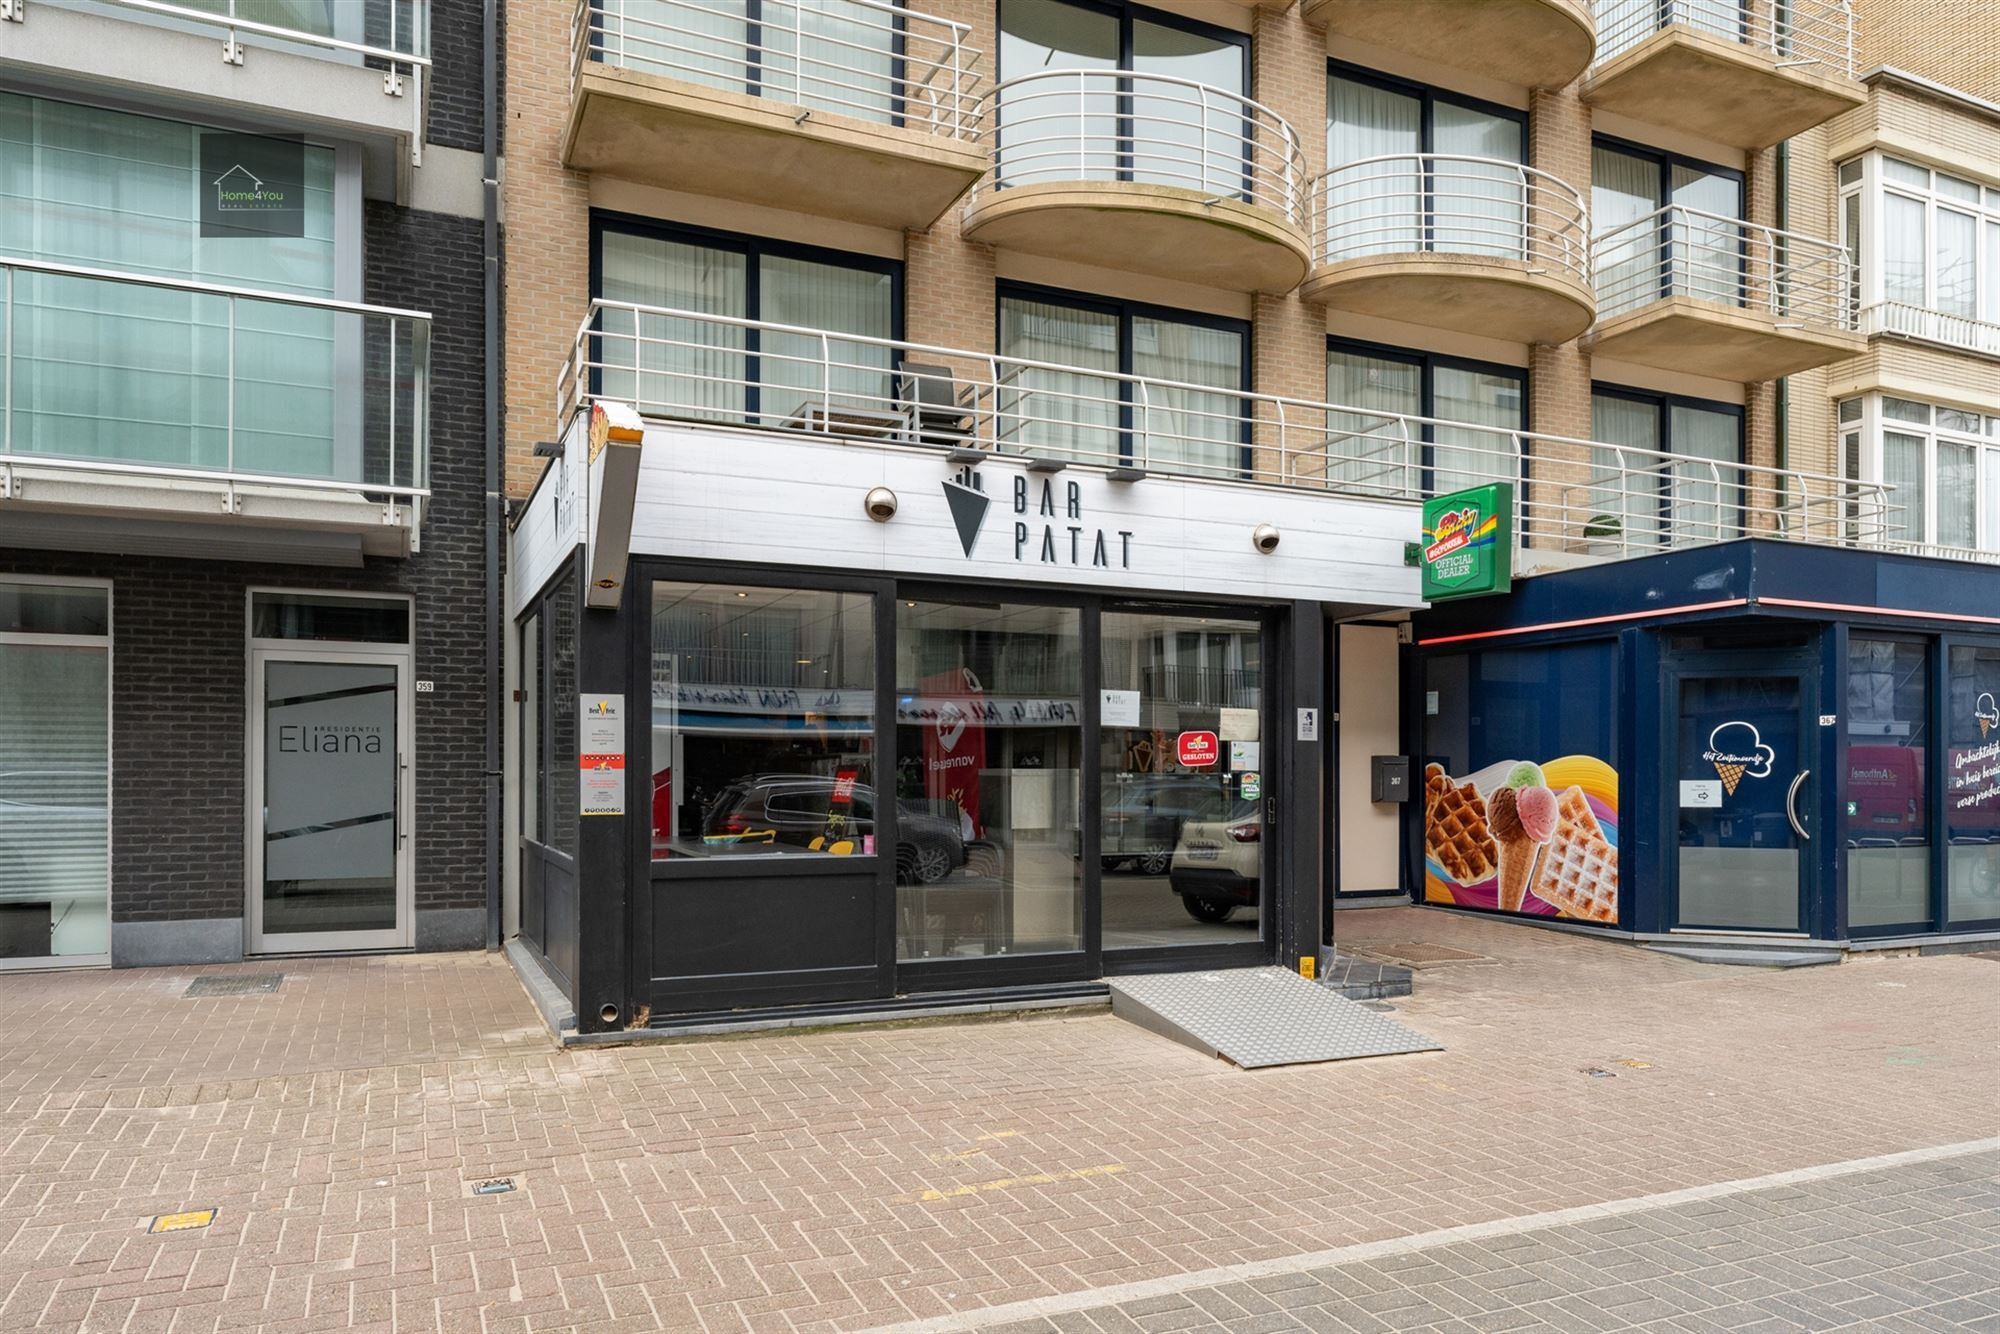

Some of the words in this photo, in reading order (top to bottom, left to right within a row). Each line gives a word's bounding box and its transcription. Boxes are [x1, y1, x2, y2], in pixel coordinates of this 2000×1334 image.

[1014, 475, 1080, 519] BAR
[1015, 521, 1133, 568] PATAT
[1435, 554, 1473, 569] OFFICIAL
[1438, 565, 1470, 579] DEALER
[418, 682, 432, 691] 359
[279, 726, 381, 753] Eliana
[1182, 752, 1215, 761] GESLOTEN
[1703, 751, 1716, 761] Het
[1956, 776, 1964, 788] in
[1966, 770, 1981, 785] huis
[1957, 795, 1975, 808] verse
